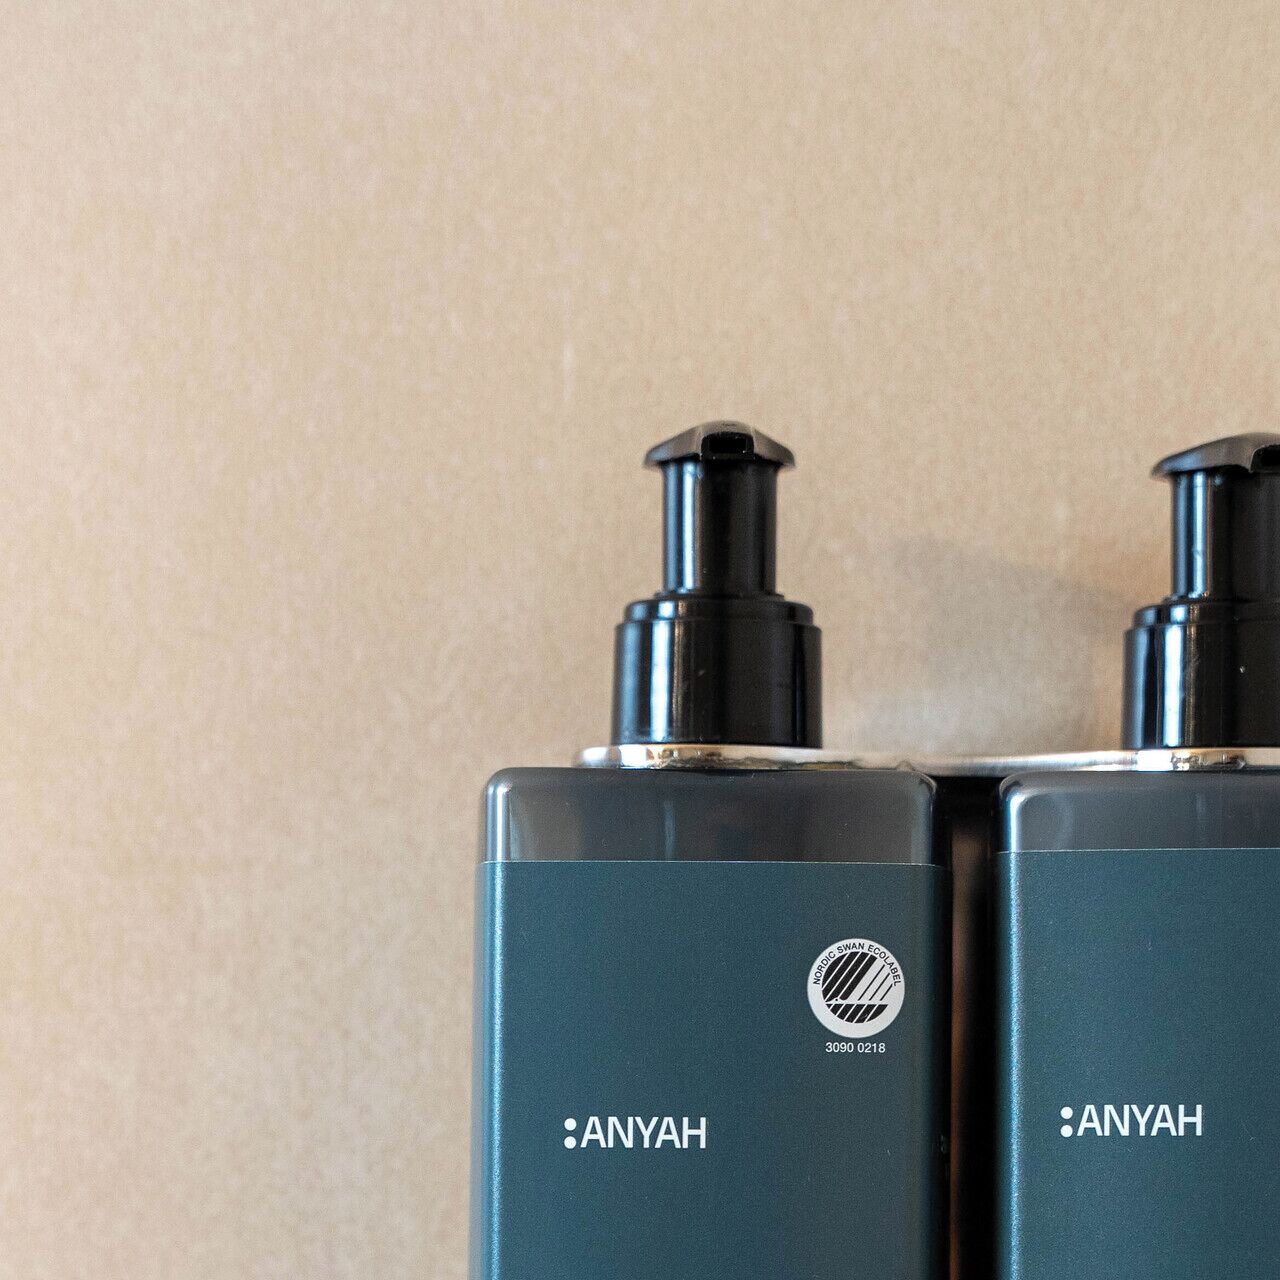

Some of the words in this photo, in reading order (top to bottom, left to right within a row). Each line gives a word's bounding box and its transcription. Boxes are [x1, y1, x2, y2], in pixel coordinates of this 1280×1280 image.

[813, 951, 836, 985] NORDIC
[837, 943, 864, 953] SWAN
[868, 945, 901, 987] ECOLABEL
[826, 1042, 854, 1052] 3090
[857, 1043, 885, 1053] 0218
